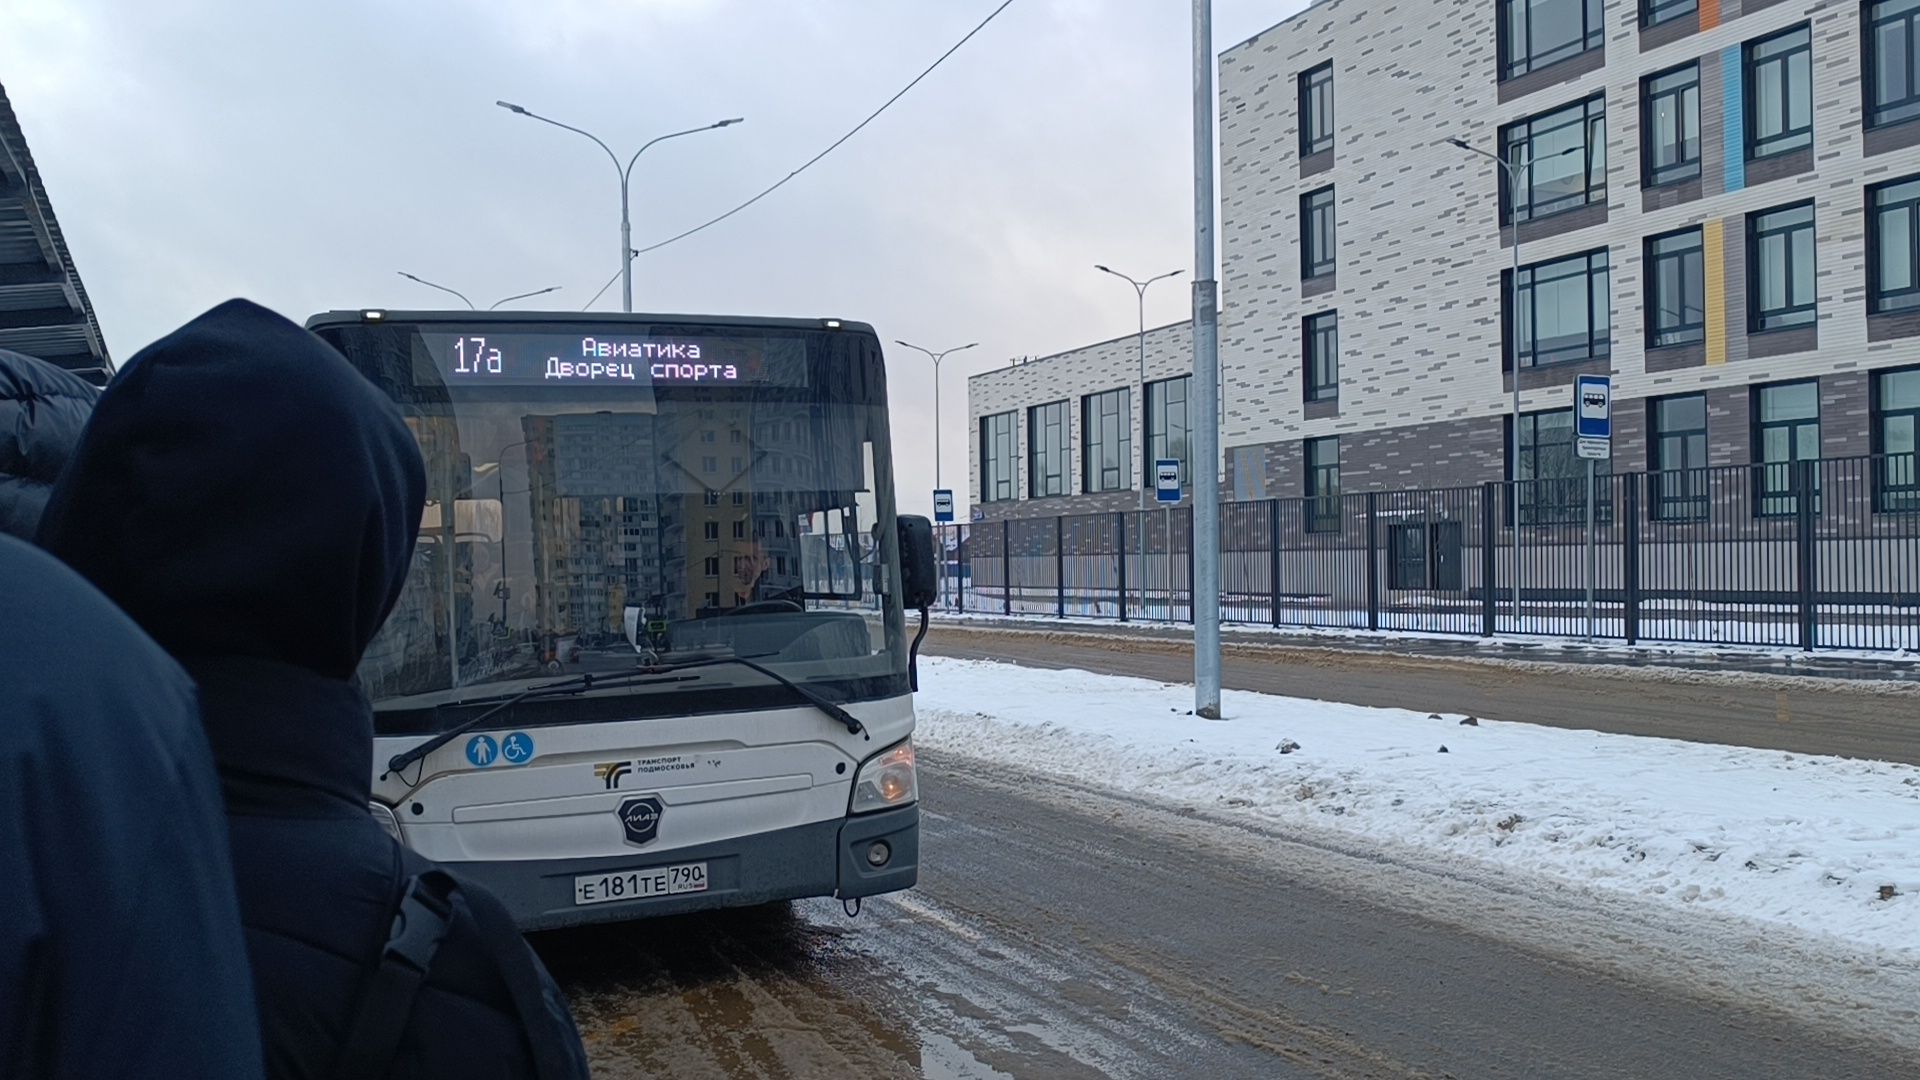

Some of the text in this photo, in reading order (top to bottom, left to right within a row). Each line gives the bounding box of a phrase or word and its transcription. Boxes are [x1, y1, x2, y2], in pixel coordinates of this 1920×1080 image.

[454, 337, 502, 374] 17а
[582, 337, 701, 359] Авиатика
[545, 357, 738, 381] Дворец спорта
[637, 756, 682, 766] ТРАНСПОРТ
[637, 762, 695, 773] ПОДМОСКОВЬЯ
[670, 866, 702, 884] 790
